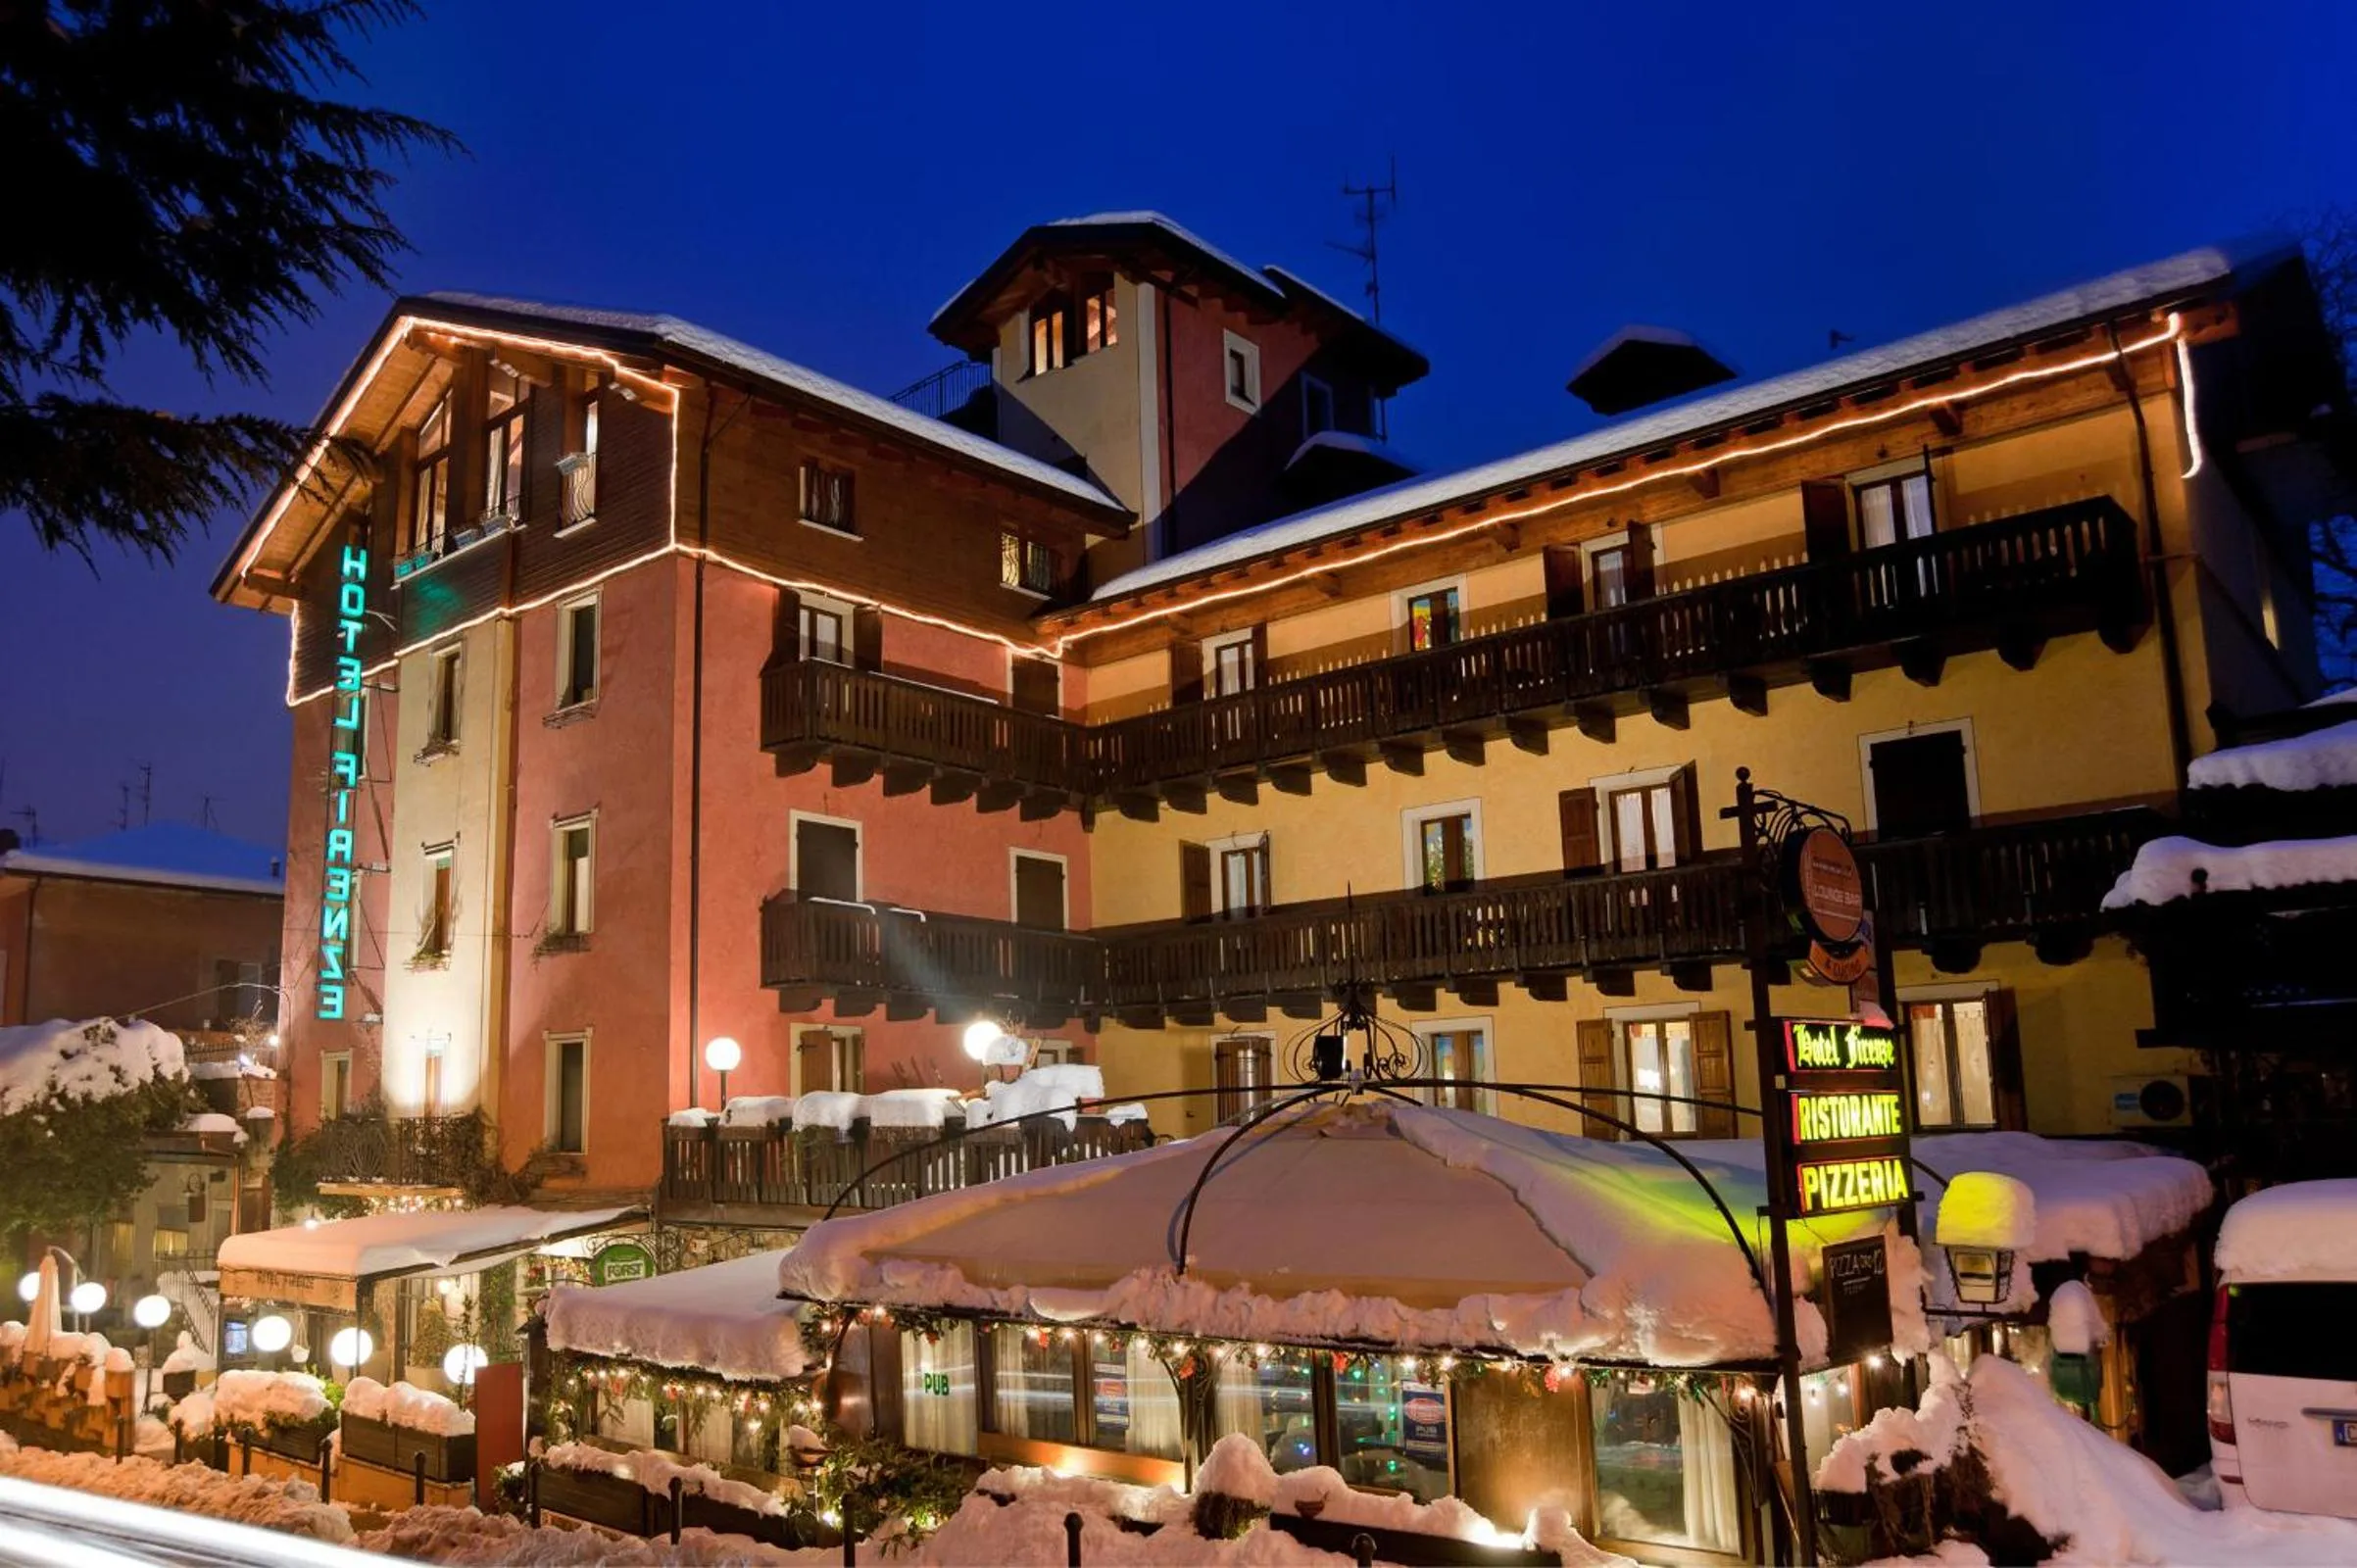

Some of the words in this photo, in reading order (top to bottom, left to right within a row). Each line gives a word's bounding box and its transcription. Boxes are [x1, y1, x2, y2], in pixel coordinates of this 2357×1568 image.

[1792, 1024, 1841, 1067] Hotel
[1845, 1024, 1895, 1068] Firenze
[1798, 1094, 1901, 1141] RISTORANTE
[1801, 1159, 1909, 1211] PIZZERIA
[924, 1372, 951, 1396] PUB
